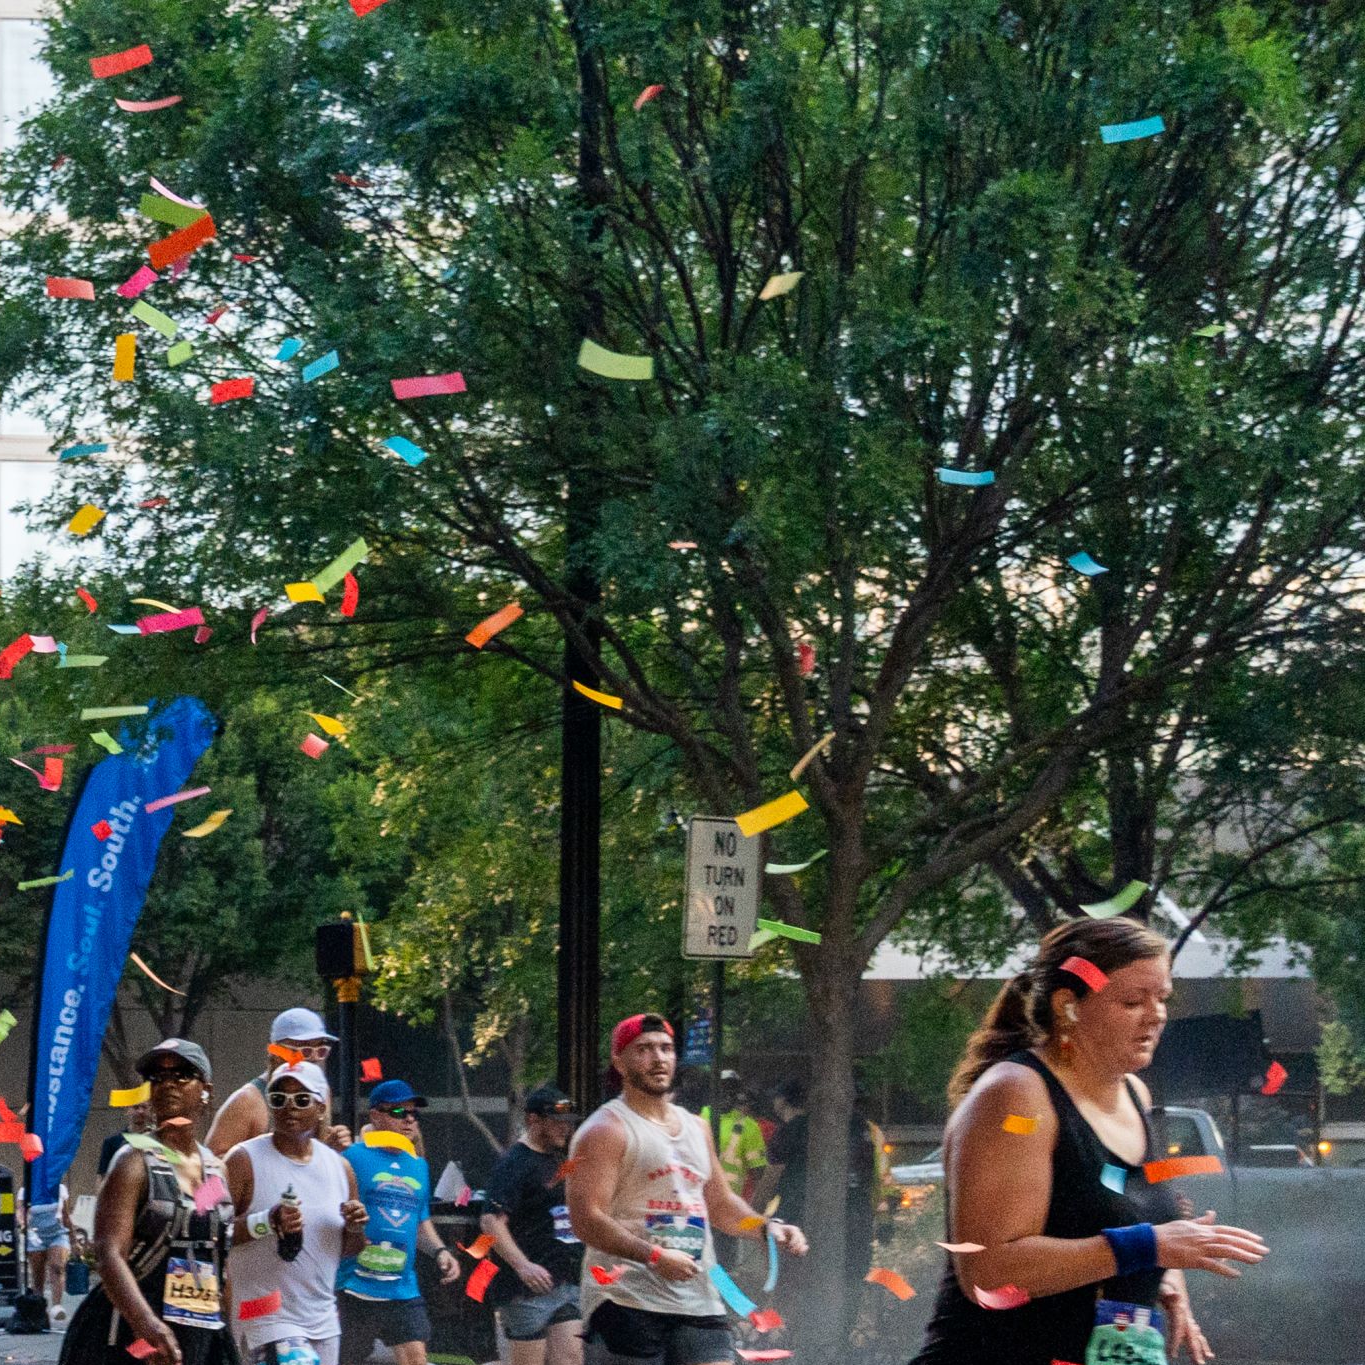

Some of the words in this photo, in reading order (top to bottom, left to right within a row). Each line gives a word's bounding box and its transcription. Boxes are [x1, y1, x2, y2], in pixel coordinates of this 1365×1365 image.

[87, 795, 143, 893] South.
[715, 831, 737, 857] NO
[704, 864, 745, 887] TURN
[714, 895, 736, 916] ON
[707, 925, 739, 946] RED
